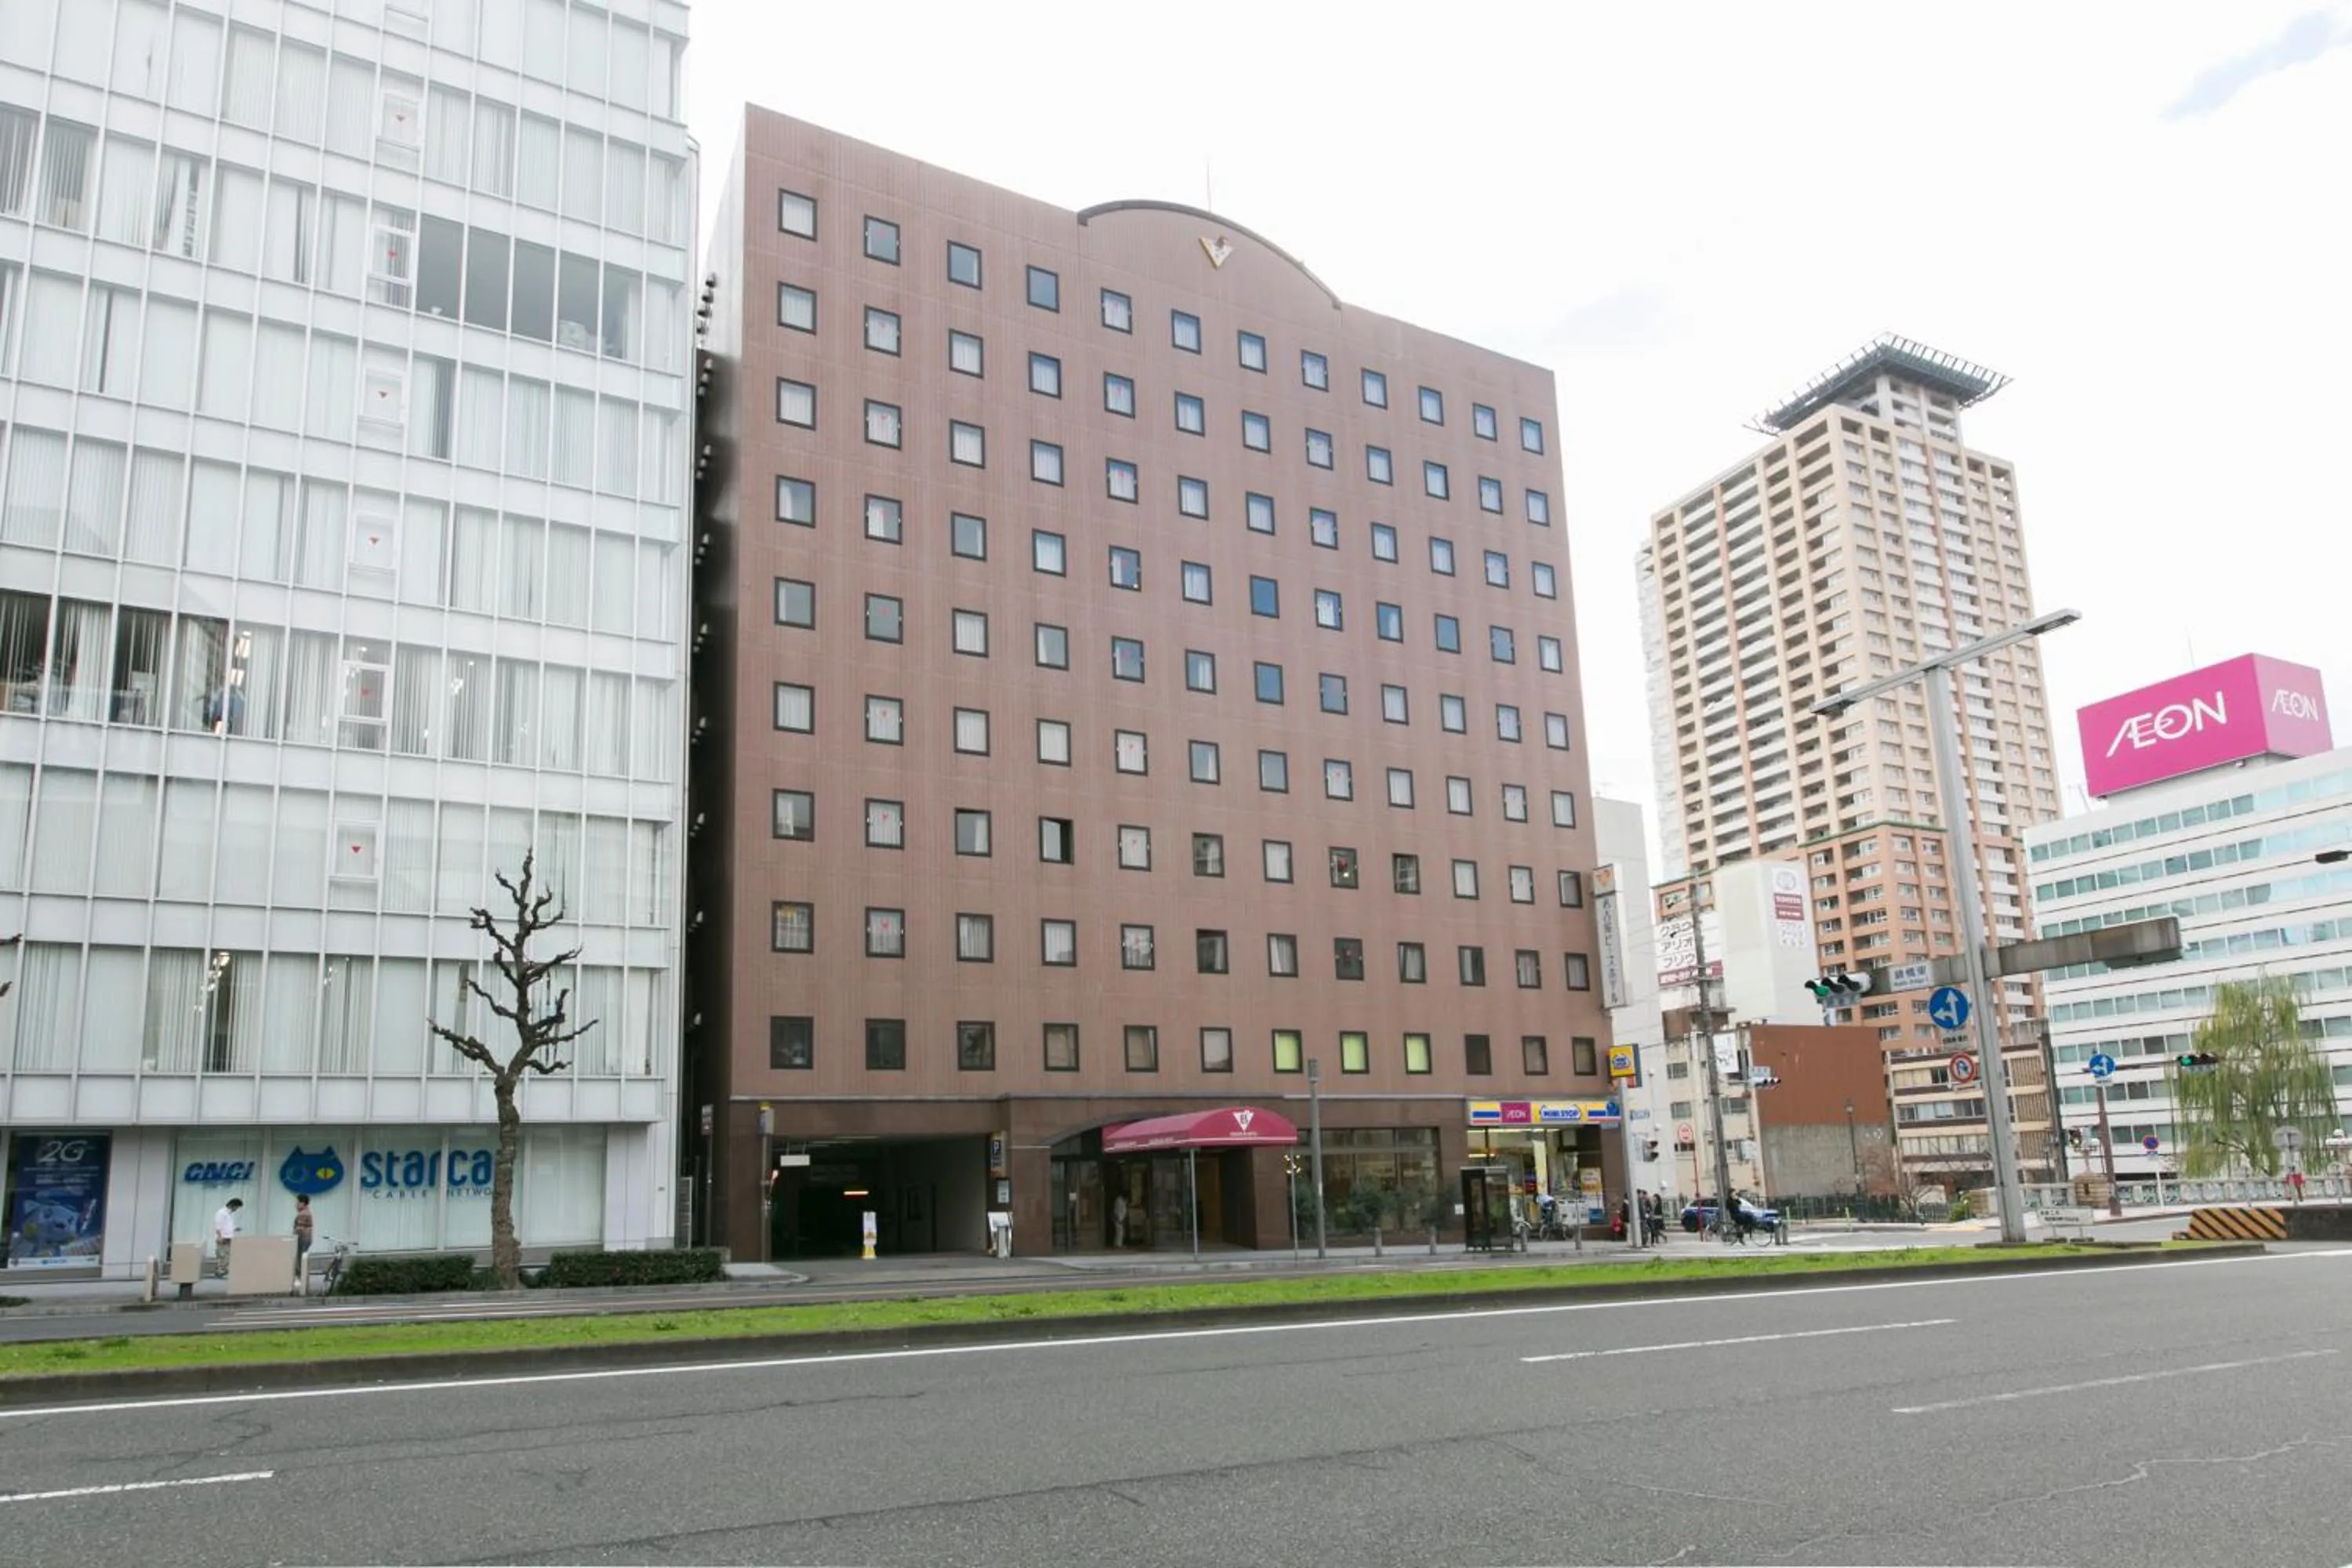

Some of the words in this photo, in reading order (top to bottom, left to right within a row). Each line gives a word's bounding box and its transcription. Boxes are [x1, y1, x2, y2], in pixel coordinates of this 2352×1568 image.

[38, 1139, 89, 1163] 2G
[361, 1149, 493, 1188] starca
[373, 1189, 428, 1200] CABLE
[446, 1188, 494, 1198] NETWO
